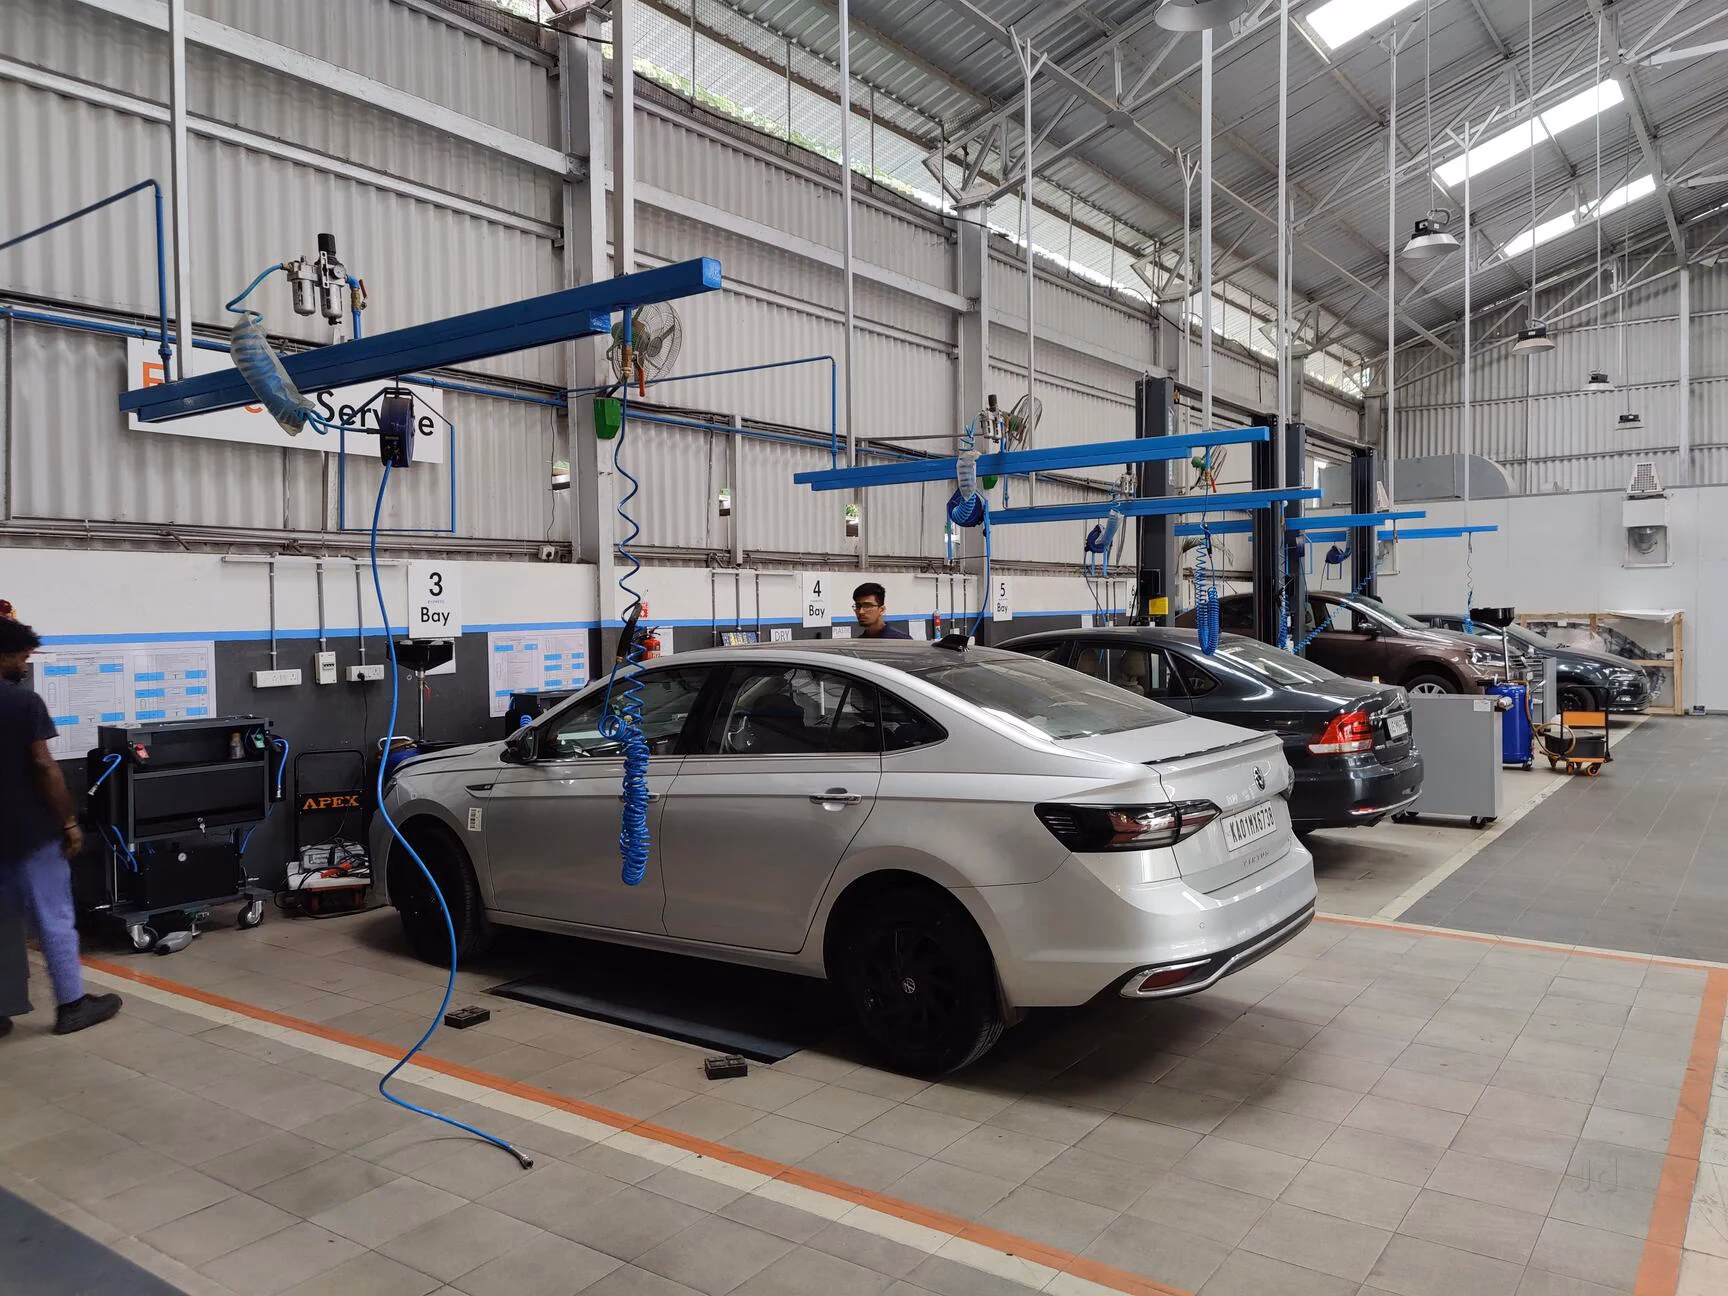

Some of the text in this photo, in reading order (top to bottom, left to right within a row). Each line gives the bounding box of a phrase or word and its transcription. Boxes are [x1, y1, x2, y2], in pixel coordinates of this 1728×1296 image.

[316, 390, 435, 436] Serve
[429, 572, 443, 597] 3
[813, 580, 821, 597] 4
[1000, 583, 1006, 597] 5
[808, 605, 825, 619] Bay
[997, 602, 1008, 614] Bay
[421, 607, 450, 627] Bay
[775, 630, 790, 641] DRY
[303, 795, 360, 810] APEX
[1229, 806, 1274, 843] KA01MX6738
